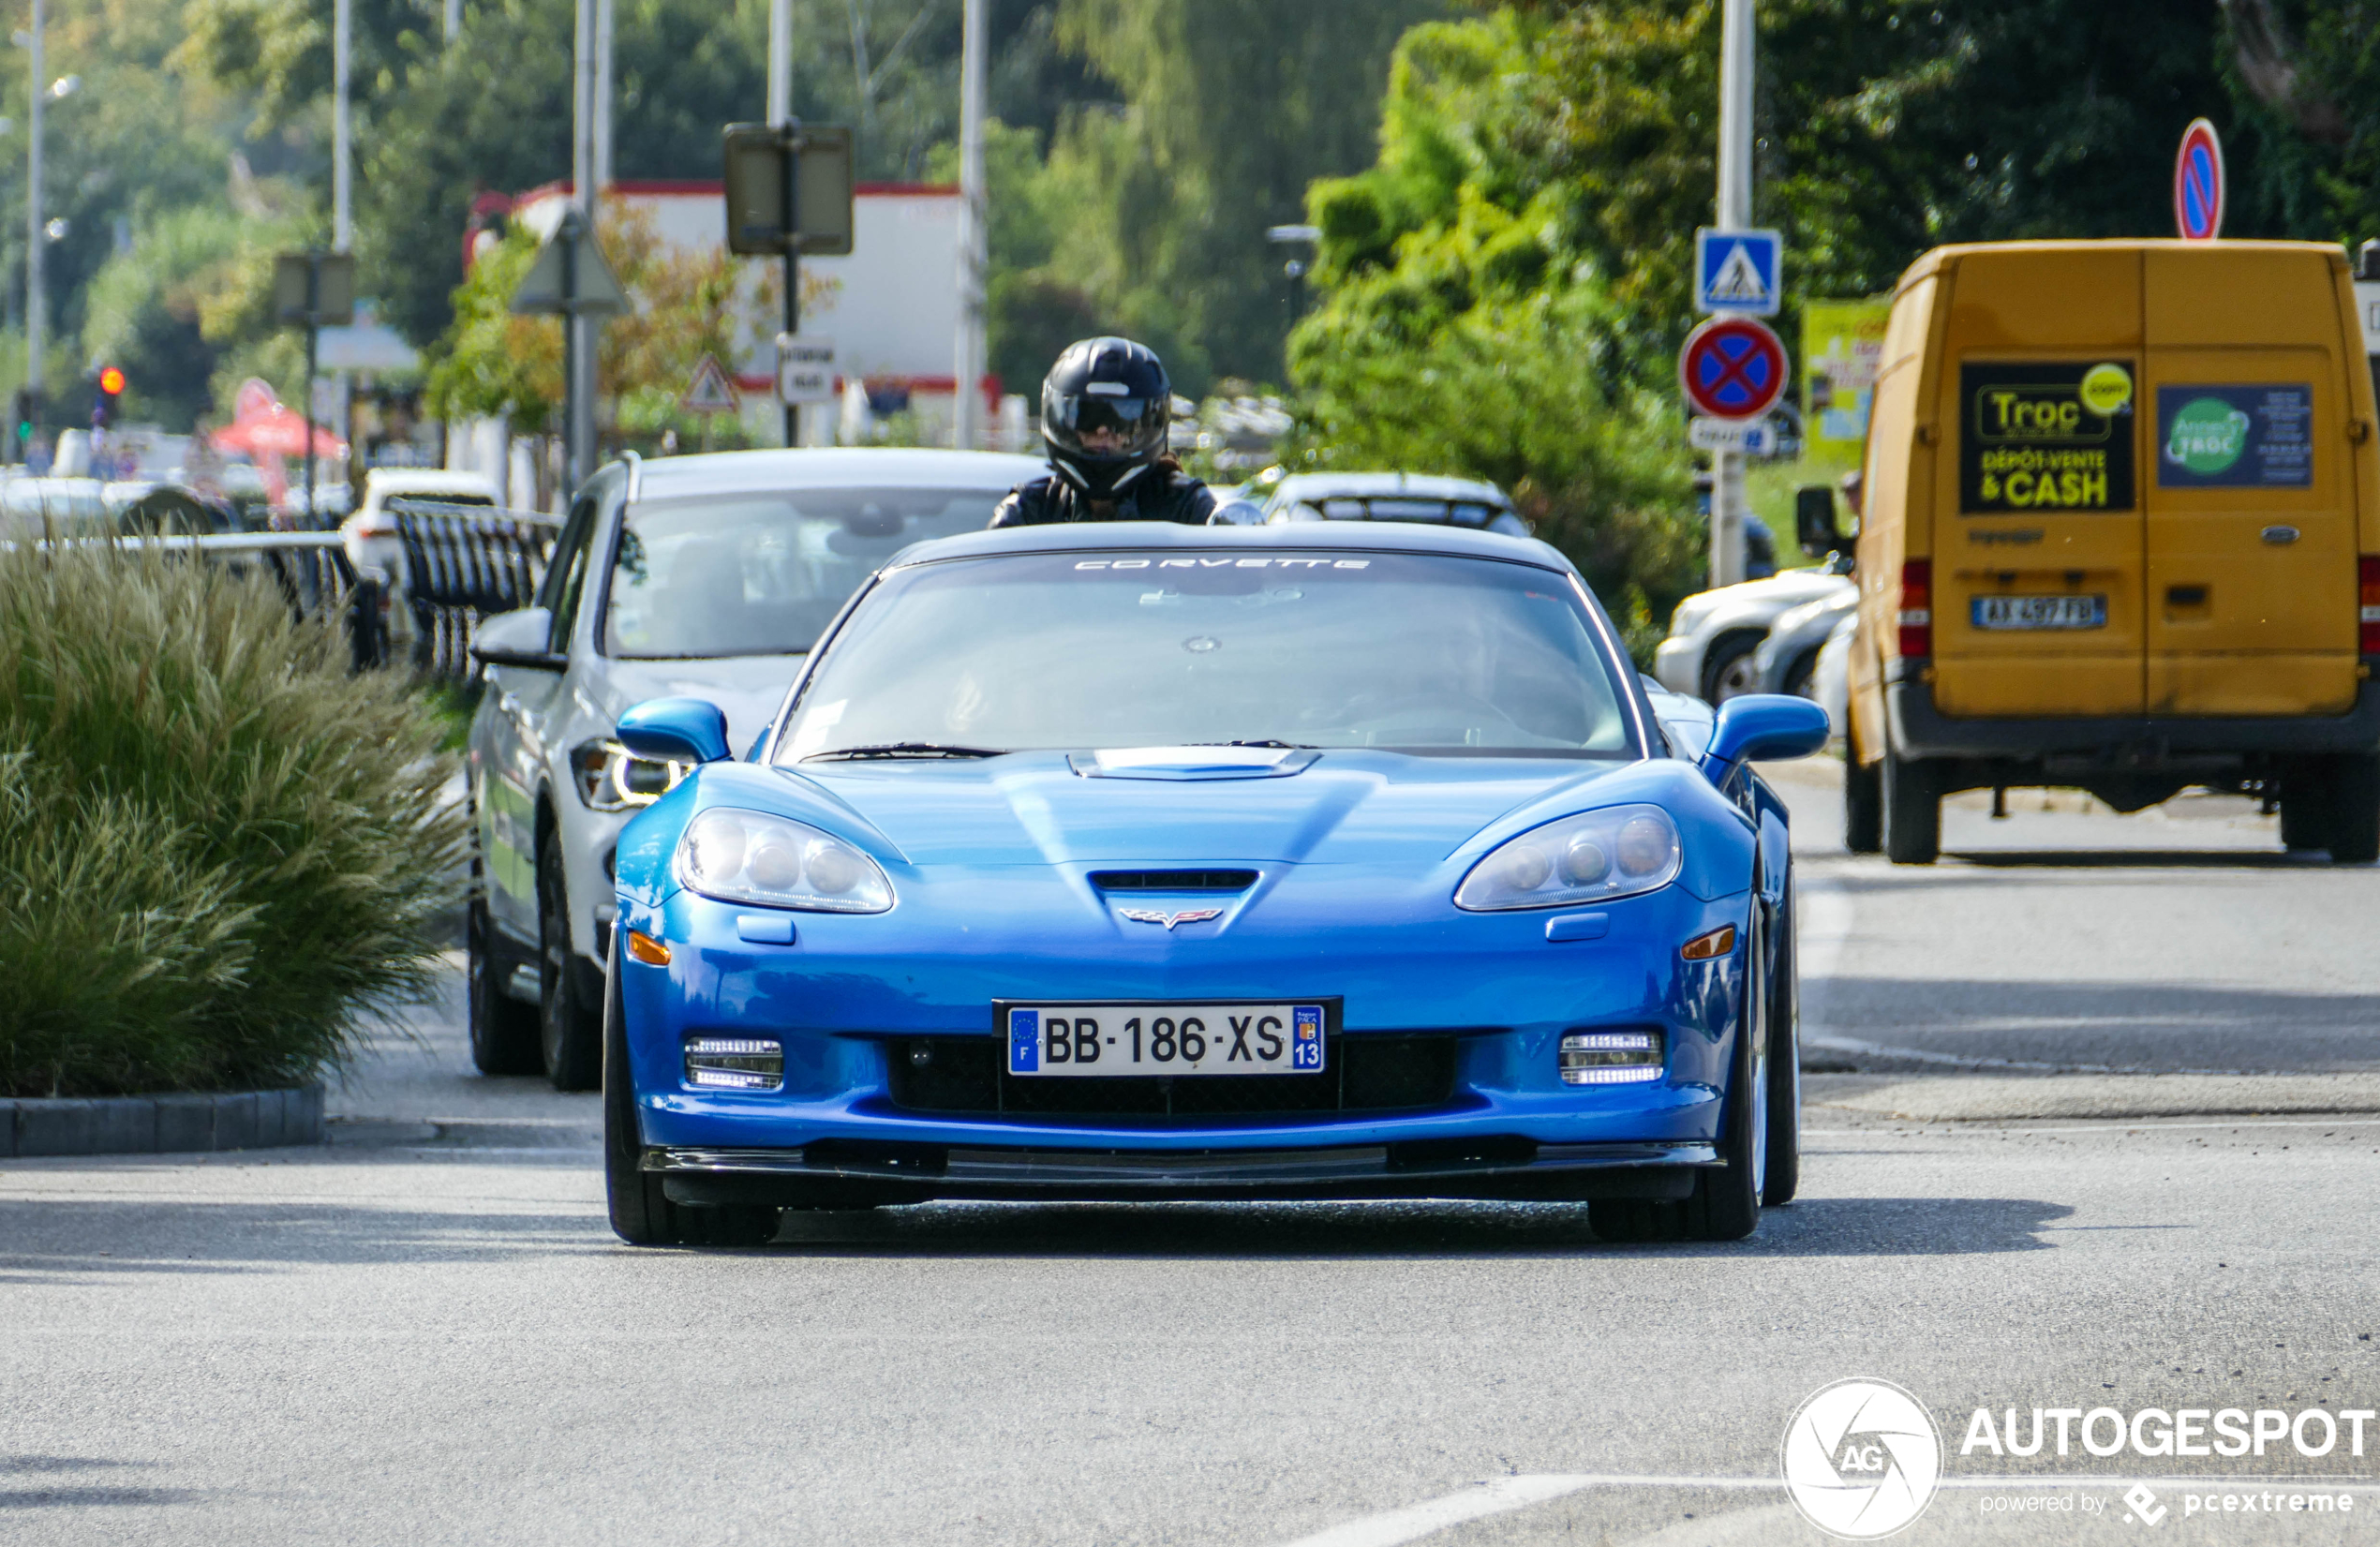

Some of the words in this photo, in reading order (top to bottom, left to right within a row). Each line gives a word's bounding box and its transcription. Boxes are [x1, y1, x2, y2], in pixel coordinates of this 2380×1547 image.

[1991, 393, 2080, 428] Troc
[2004, 471, 2106, 507] CASH
[1075, 558, 1370, 570] CORVETTE
[1019, 1047, 1029, 1060] F
[1045, 1016, 1284, 1064] BB-186-XS
[1295, 1043, 1319, 1065] 13
